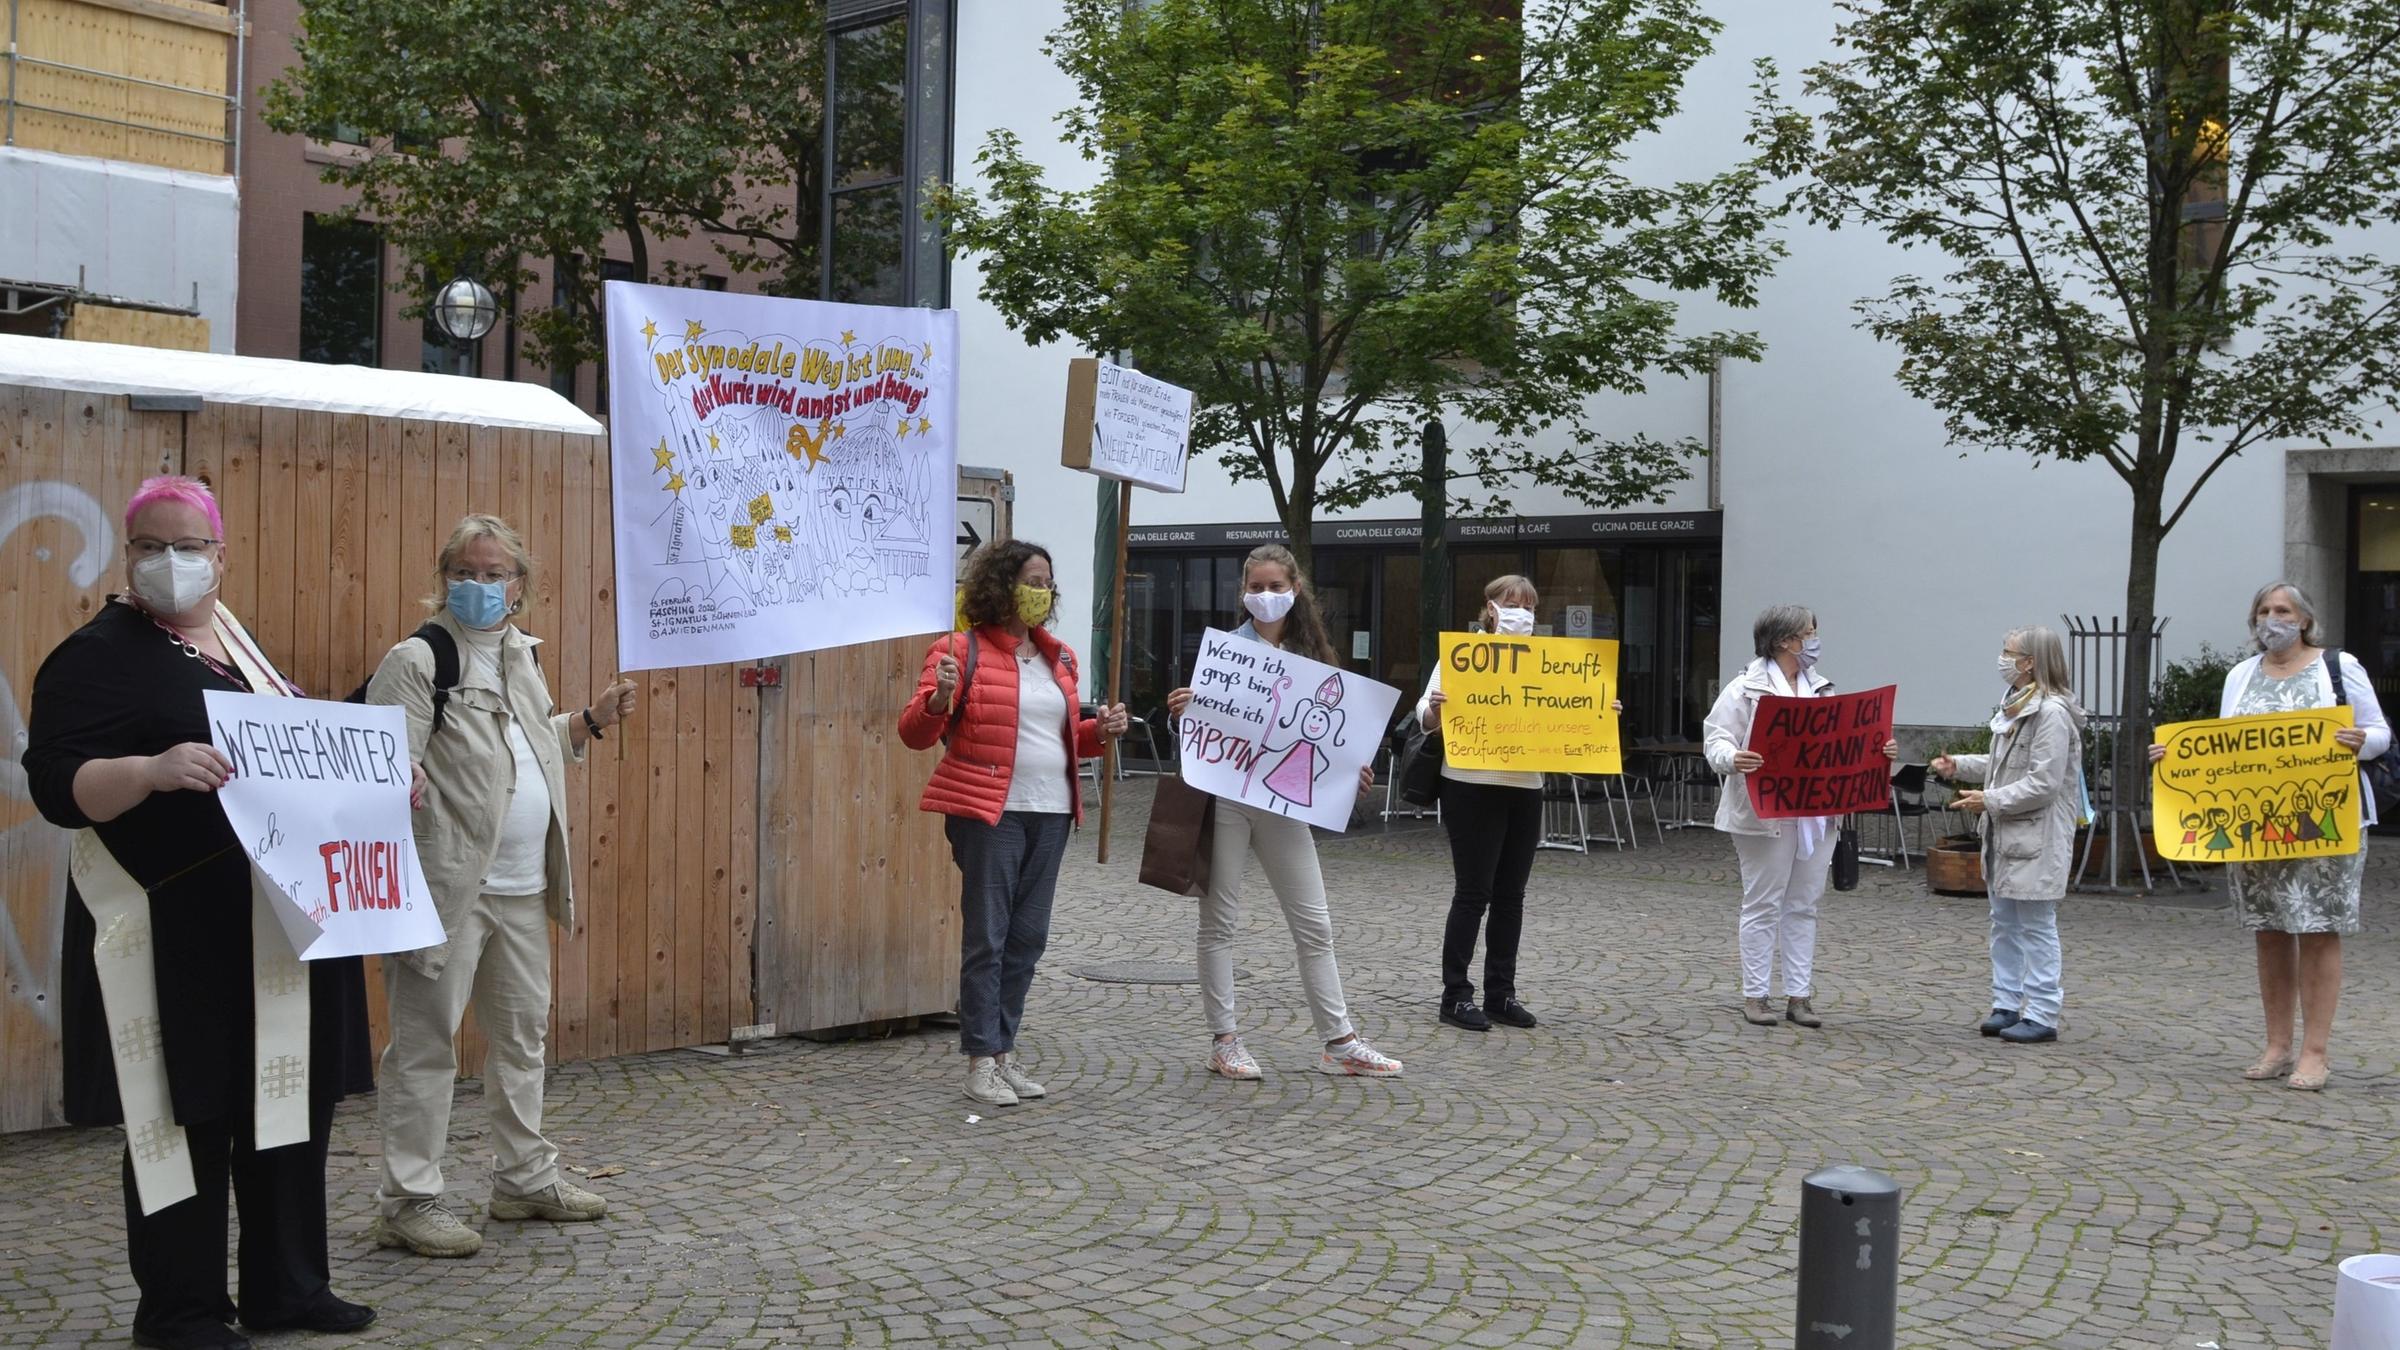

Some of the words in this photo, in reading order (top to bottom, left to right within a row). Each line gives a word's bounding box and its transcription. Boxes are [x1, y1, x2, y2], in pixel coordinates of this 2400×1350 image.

[655, 348, 686, 385] Der
[800, 348, 843, 390] Weg
[846, 352, 872, 382] ist
[1100, 366, 1120, 386] GOTT
[1155, 386, 1171, 402] Erde
[691, 384, 714, 421] der
[756, 379, 796, 415] wird
[796, 387, 851, 420] angst
[853, 374, 884, 408] und
[1161, 423, 1180, 443] Zugang
[1147, 532, 1168, 541] DELLE
[1169, 531, 1196, 540] GRAZIE
[1226, 530, 1273, 540] RESTAURANT
[1274, 531, 1280, 539] &
[1336, 528, 1367, 538] CUCINA
[1368, 528, 1393, 537] DELLE
[1461, 525, 1515, 535] RESTAURANT
[1518, 525, 1525, 534] &
[1527, 522, 1551, 533] CAFÉ
[1592, 522, 1628, 532] CUCINA
[1630, 521, 1658, 531] DELLE
[1660, 520, 1695, 530] GRAZIE
[649, 605, 695, 618] FASCHING
[698, 604, 716, 613] 2020
[661, 596, 692, 607] FEBRUAR
[1206, 640, 1256, 669] Wenn
[1262, 656, 1285, 676] ich
[1450, 642, 1531, 674] GOTT
[1541, 649, 1602, 683] beruft
[1200, 668, 1241, 692] groß
[1247, 676, 1273, 703] bin,
[1466, 685, 1512, 706] auch
[1192, 694, 1240, 717] werde
[1243, 706, 1264, 724] ich
[1766, 702, 1842, 737] AUCH
[1852, 694, 1883, 729] ICH
[1449, 715, 1487, 743] Prüft
[1495, 716, 1541, 735] endlich
[1546, 721, 1592, 736] unsere
[2177, 721, 2324, 760] SCHWEIGEN
[216, 718, 406, 788] WEIHEÄMTER
[1181, 717, 1267, 774] PÄPSTIN
[1447, 739, 1525, 763] Berufungen
[1583, 743, 1609, 757] Pflicht
[1793, 733, 1867, 770] KANN
[1758, 764, 1891, 811] PRIESTERIN
[2170, 766, 2201, 780] war
[2206, 761, 2272, 785] gestern,
